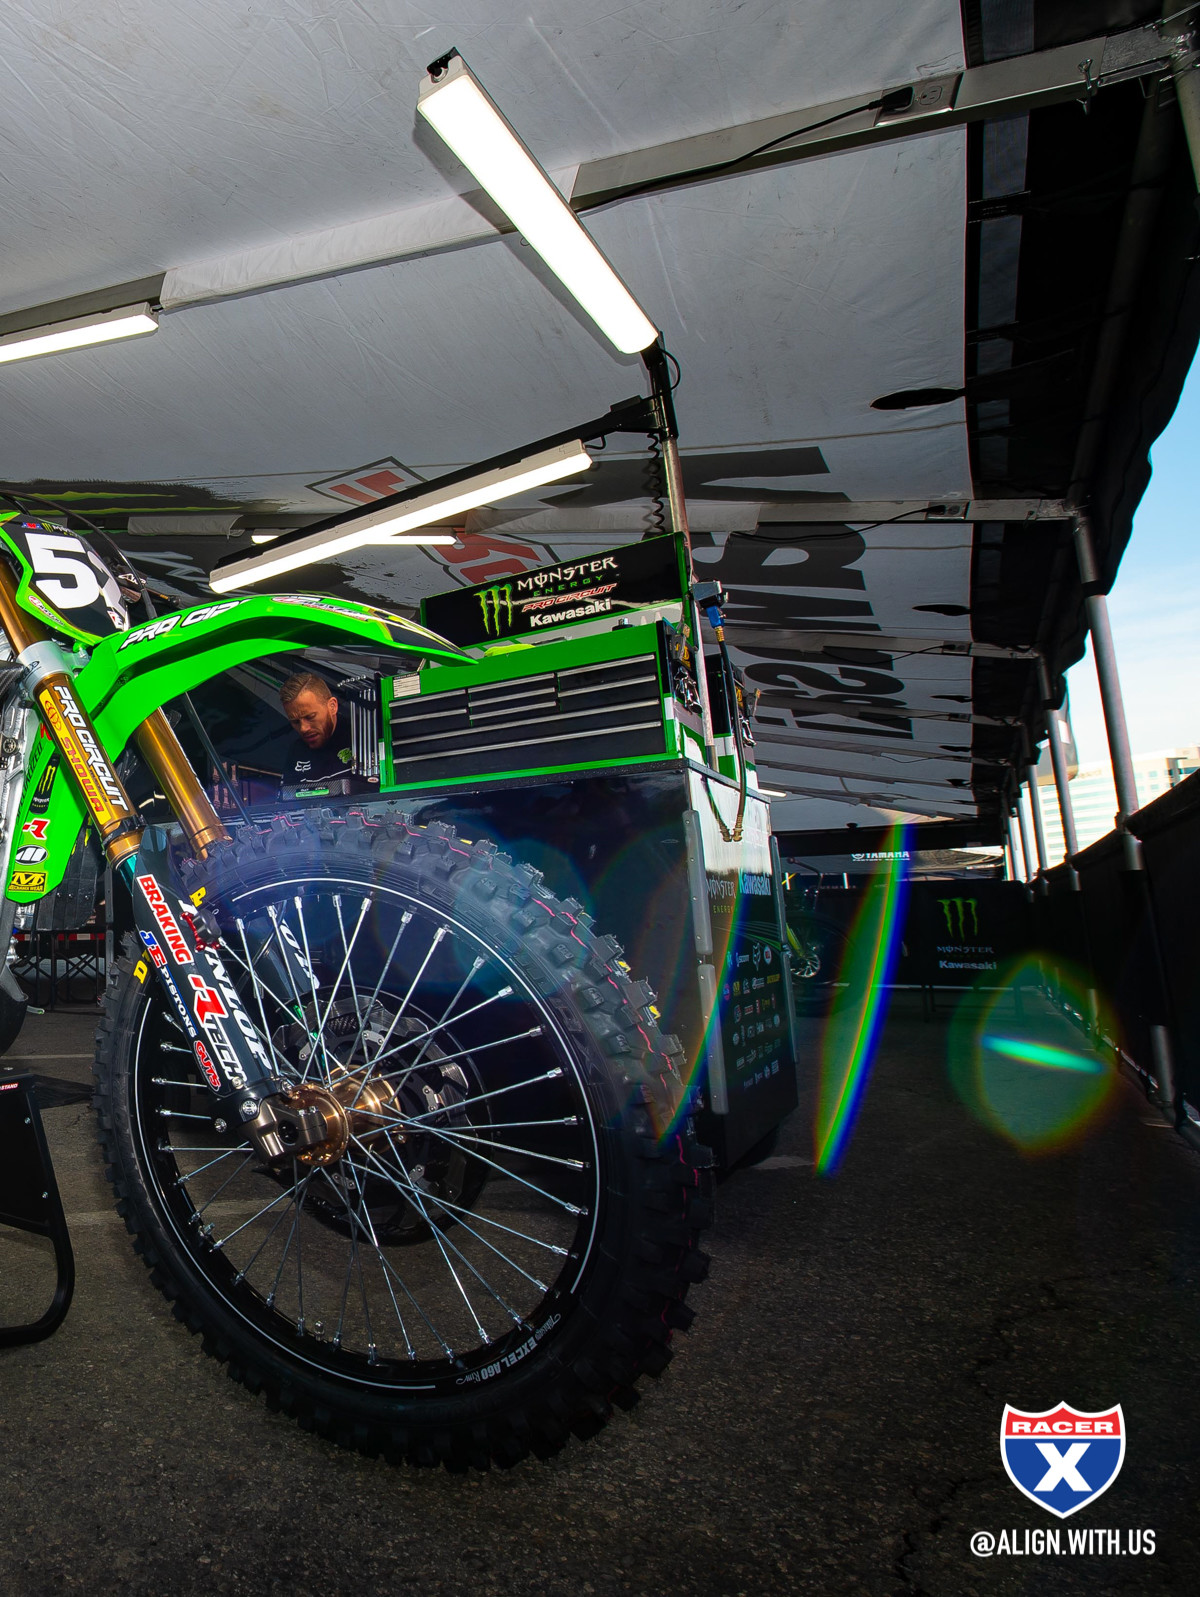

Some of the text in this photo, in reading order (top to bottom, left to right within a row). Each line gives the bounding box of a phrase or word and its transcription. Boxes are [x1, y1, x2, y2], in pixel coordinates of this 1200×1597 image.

[517, 556, 618, 591] MONSTER
[533, 575, 603, 596] ENERGY
[522, 583, 617, 612] PRO CIRCUIT
[530, 598, 612, 627] Kawasaki
[120, 615, 181, 650] PRO
[54, 686, 86, 727] PRO
[75, 726, 130, 811] CIRCUIT
[60, 736, 104, 813] SHOWA
[865, 851, 910, 859] YAMAHA
[739, 871, 772, 896] Kawasaki
[138, 875, 193, 964] BRAKING
[939, 960, 997, 970] Kawasaki
[140, 931, 167, 968] JE
[160, 967, 197, 1038] PISTONS
[194, 1040, 221, 1089] GUTS
[1, 1082, 18, 1090] STAND
[501, 1336, 538, 1367] EXCEL
[481, 1362, 501, 1380] A60
